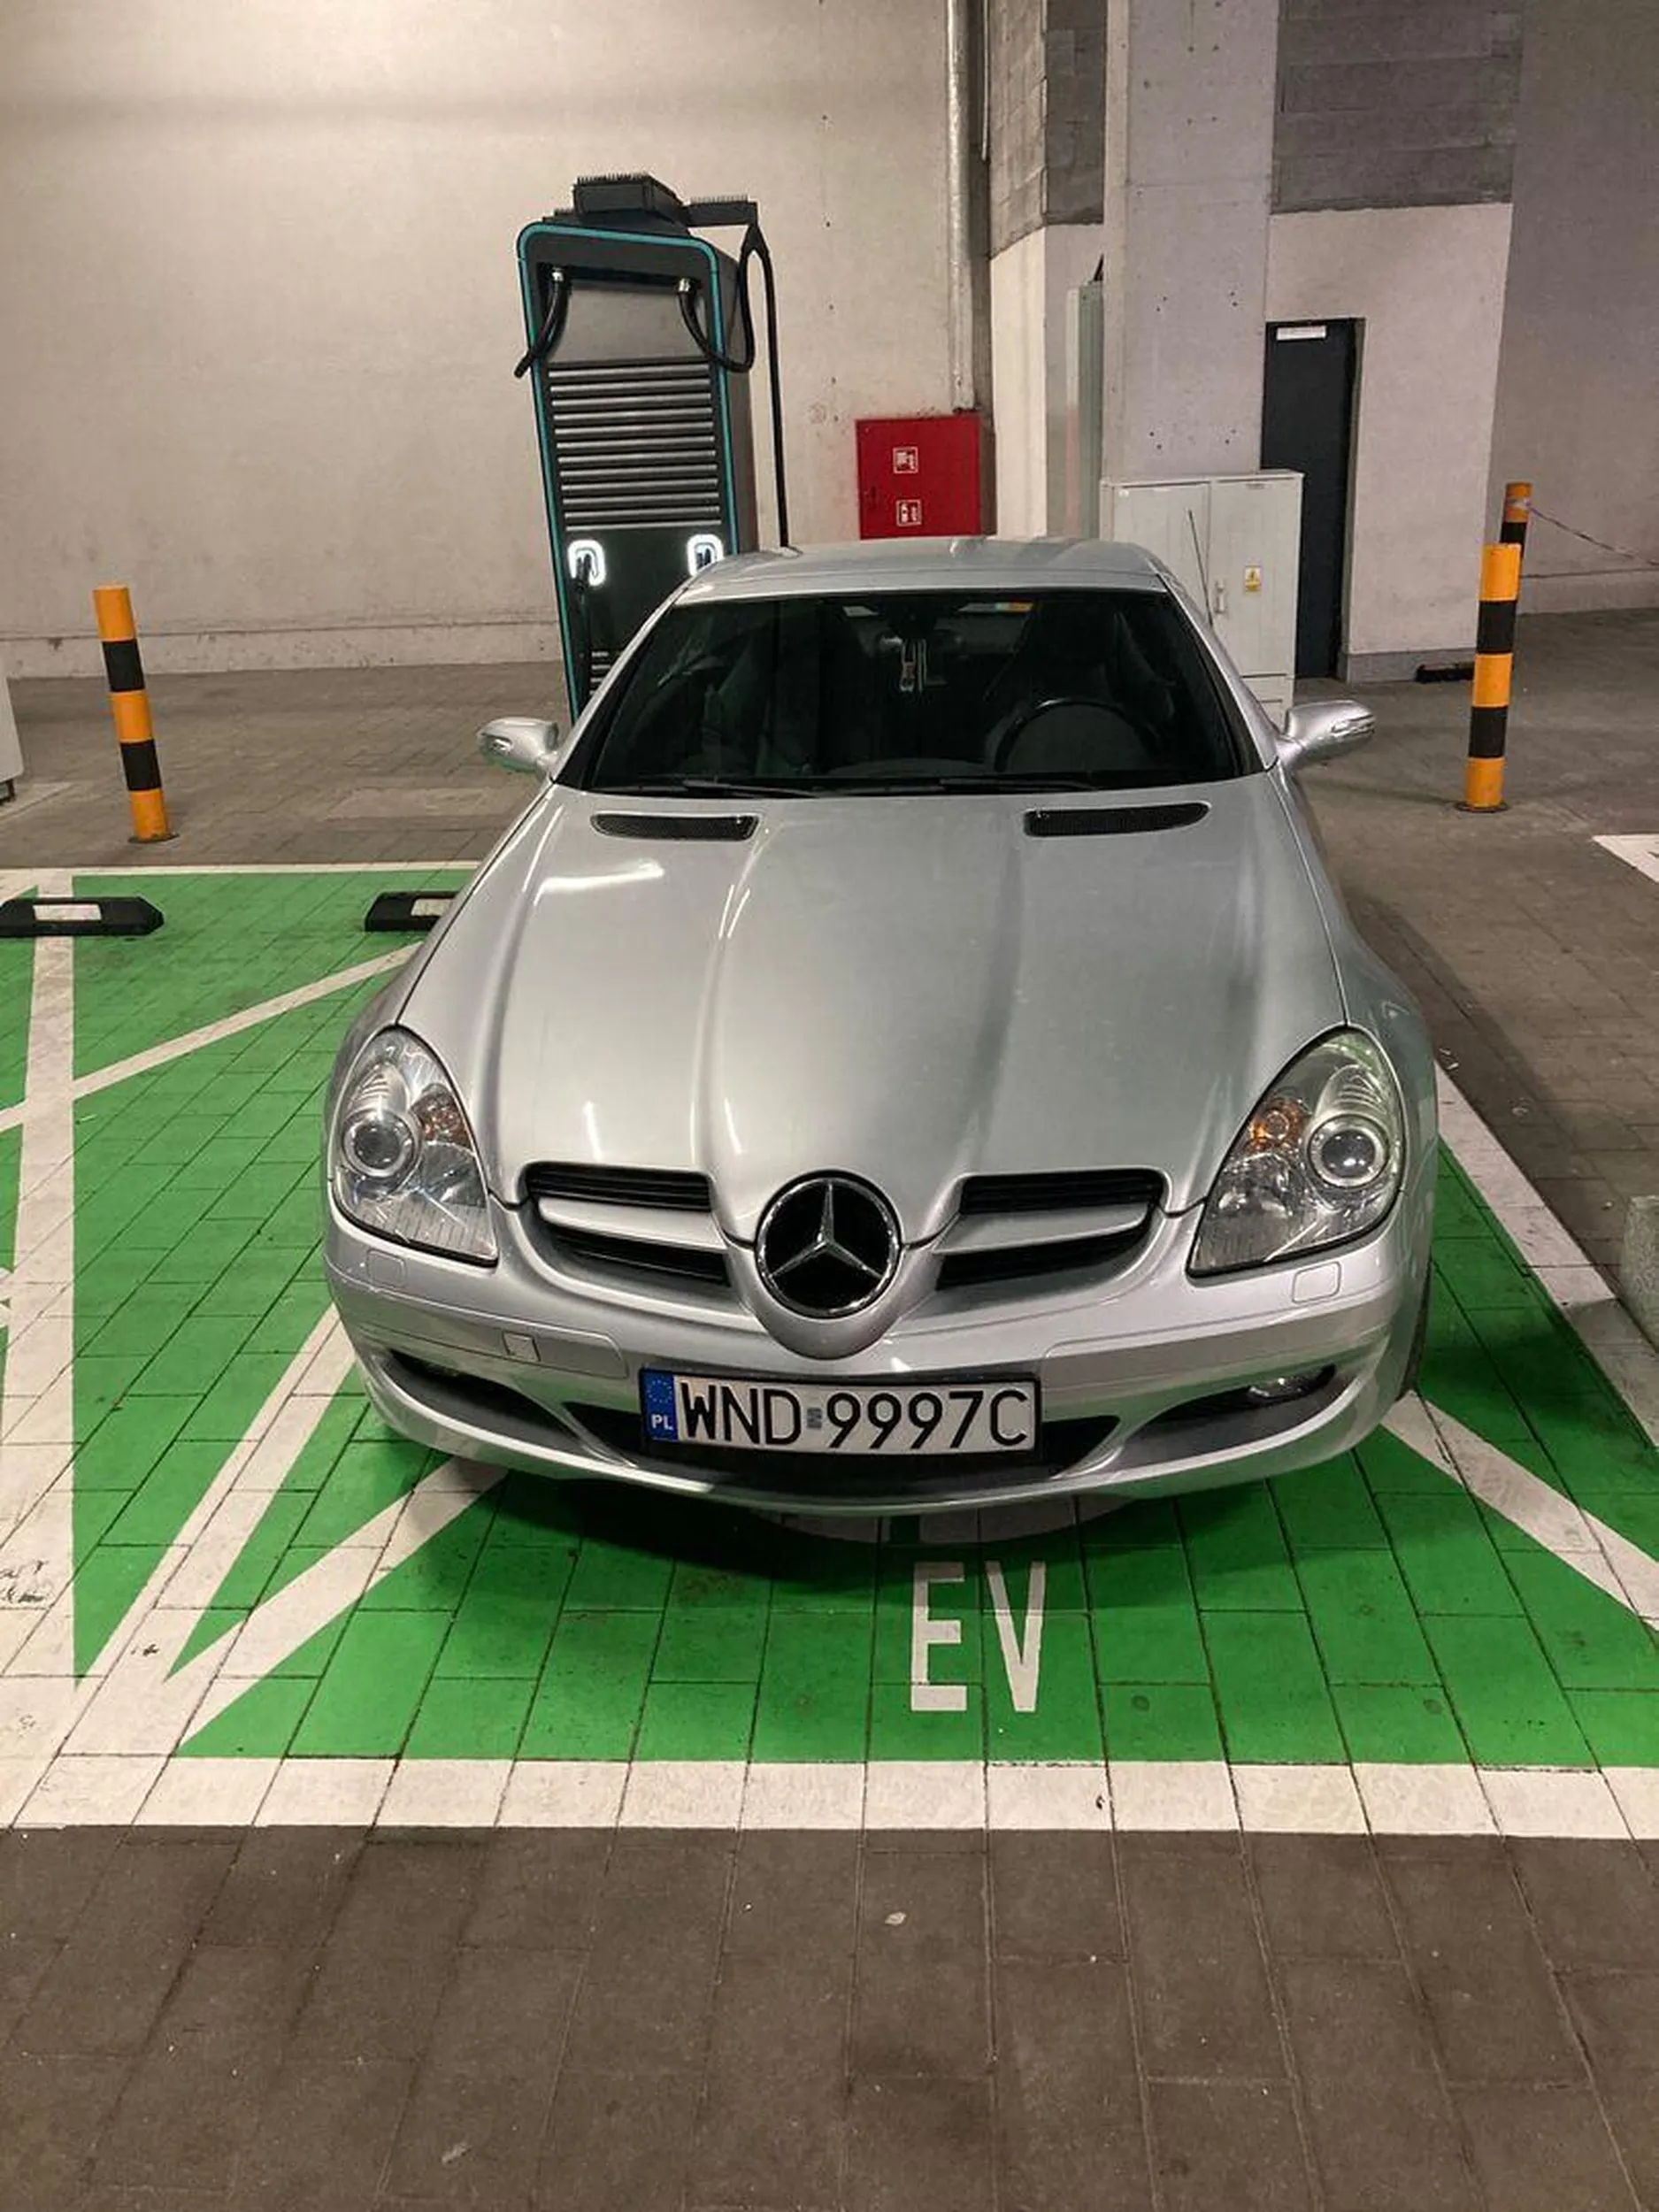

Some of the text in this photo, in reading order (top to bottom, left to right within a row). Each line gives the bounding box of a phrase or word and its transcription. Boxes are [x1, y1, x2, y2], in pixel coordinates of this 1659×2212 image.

[651, 1414, 673, 1431] PL
[680, 1382, 1029, 1449] WND 9997C
[910, 1561, 1047, 1713] EV
